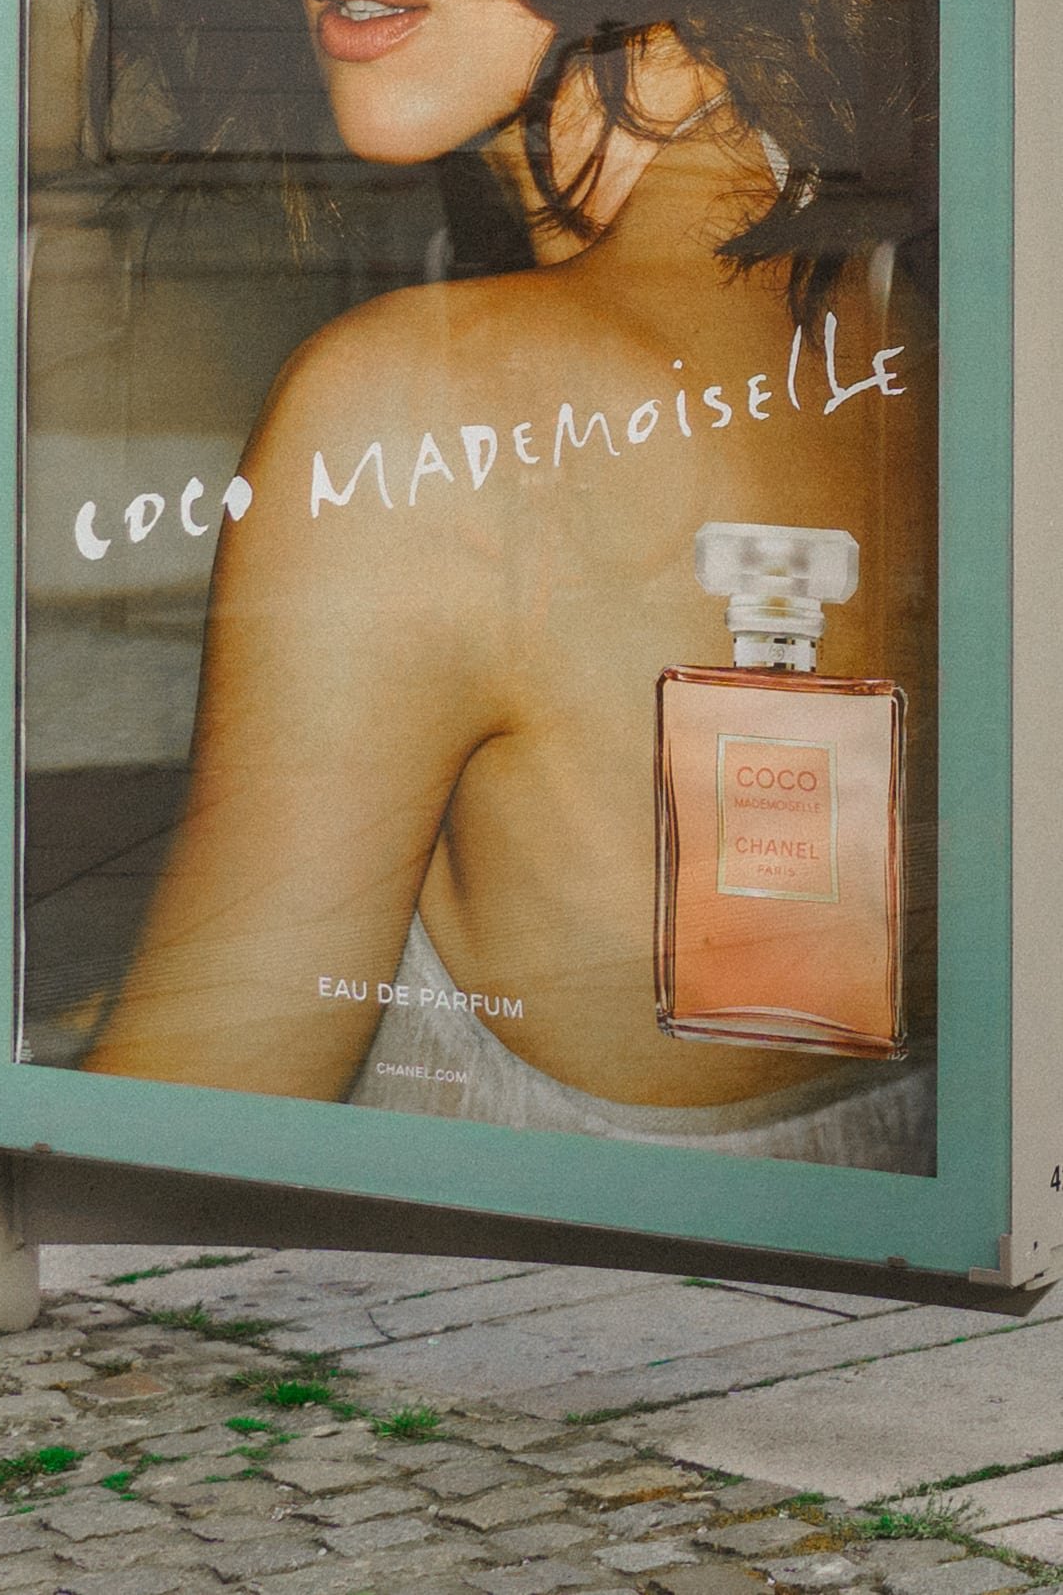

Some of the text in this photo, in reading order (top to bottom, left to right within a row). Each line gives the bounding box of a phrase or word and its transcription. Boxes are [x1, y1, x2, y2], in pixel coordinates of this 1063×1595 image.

[74, 475, 253, 561] COCO
[737, 766, 817, 792] COCO
[735, 798, 821, 814] MADEMOISELLE
[736, 836, 820, 860] CHANEL
[758, 864, 795, 878] PARIS
[318, 977, 524, 1019] EAU DE PARFUM
[376, 1062, 468, 1084] CHANEL.COM
